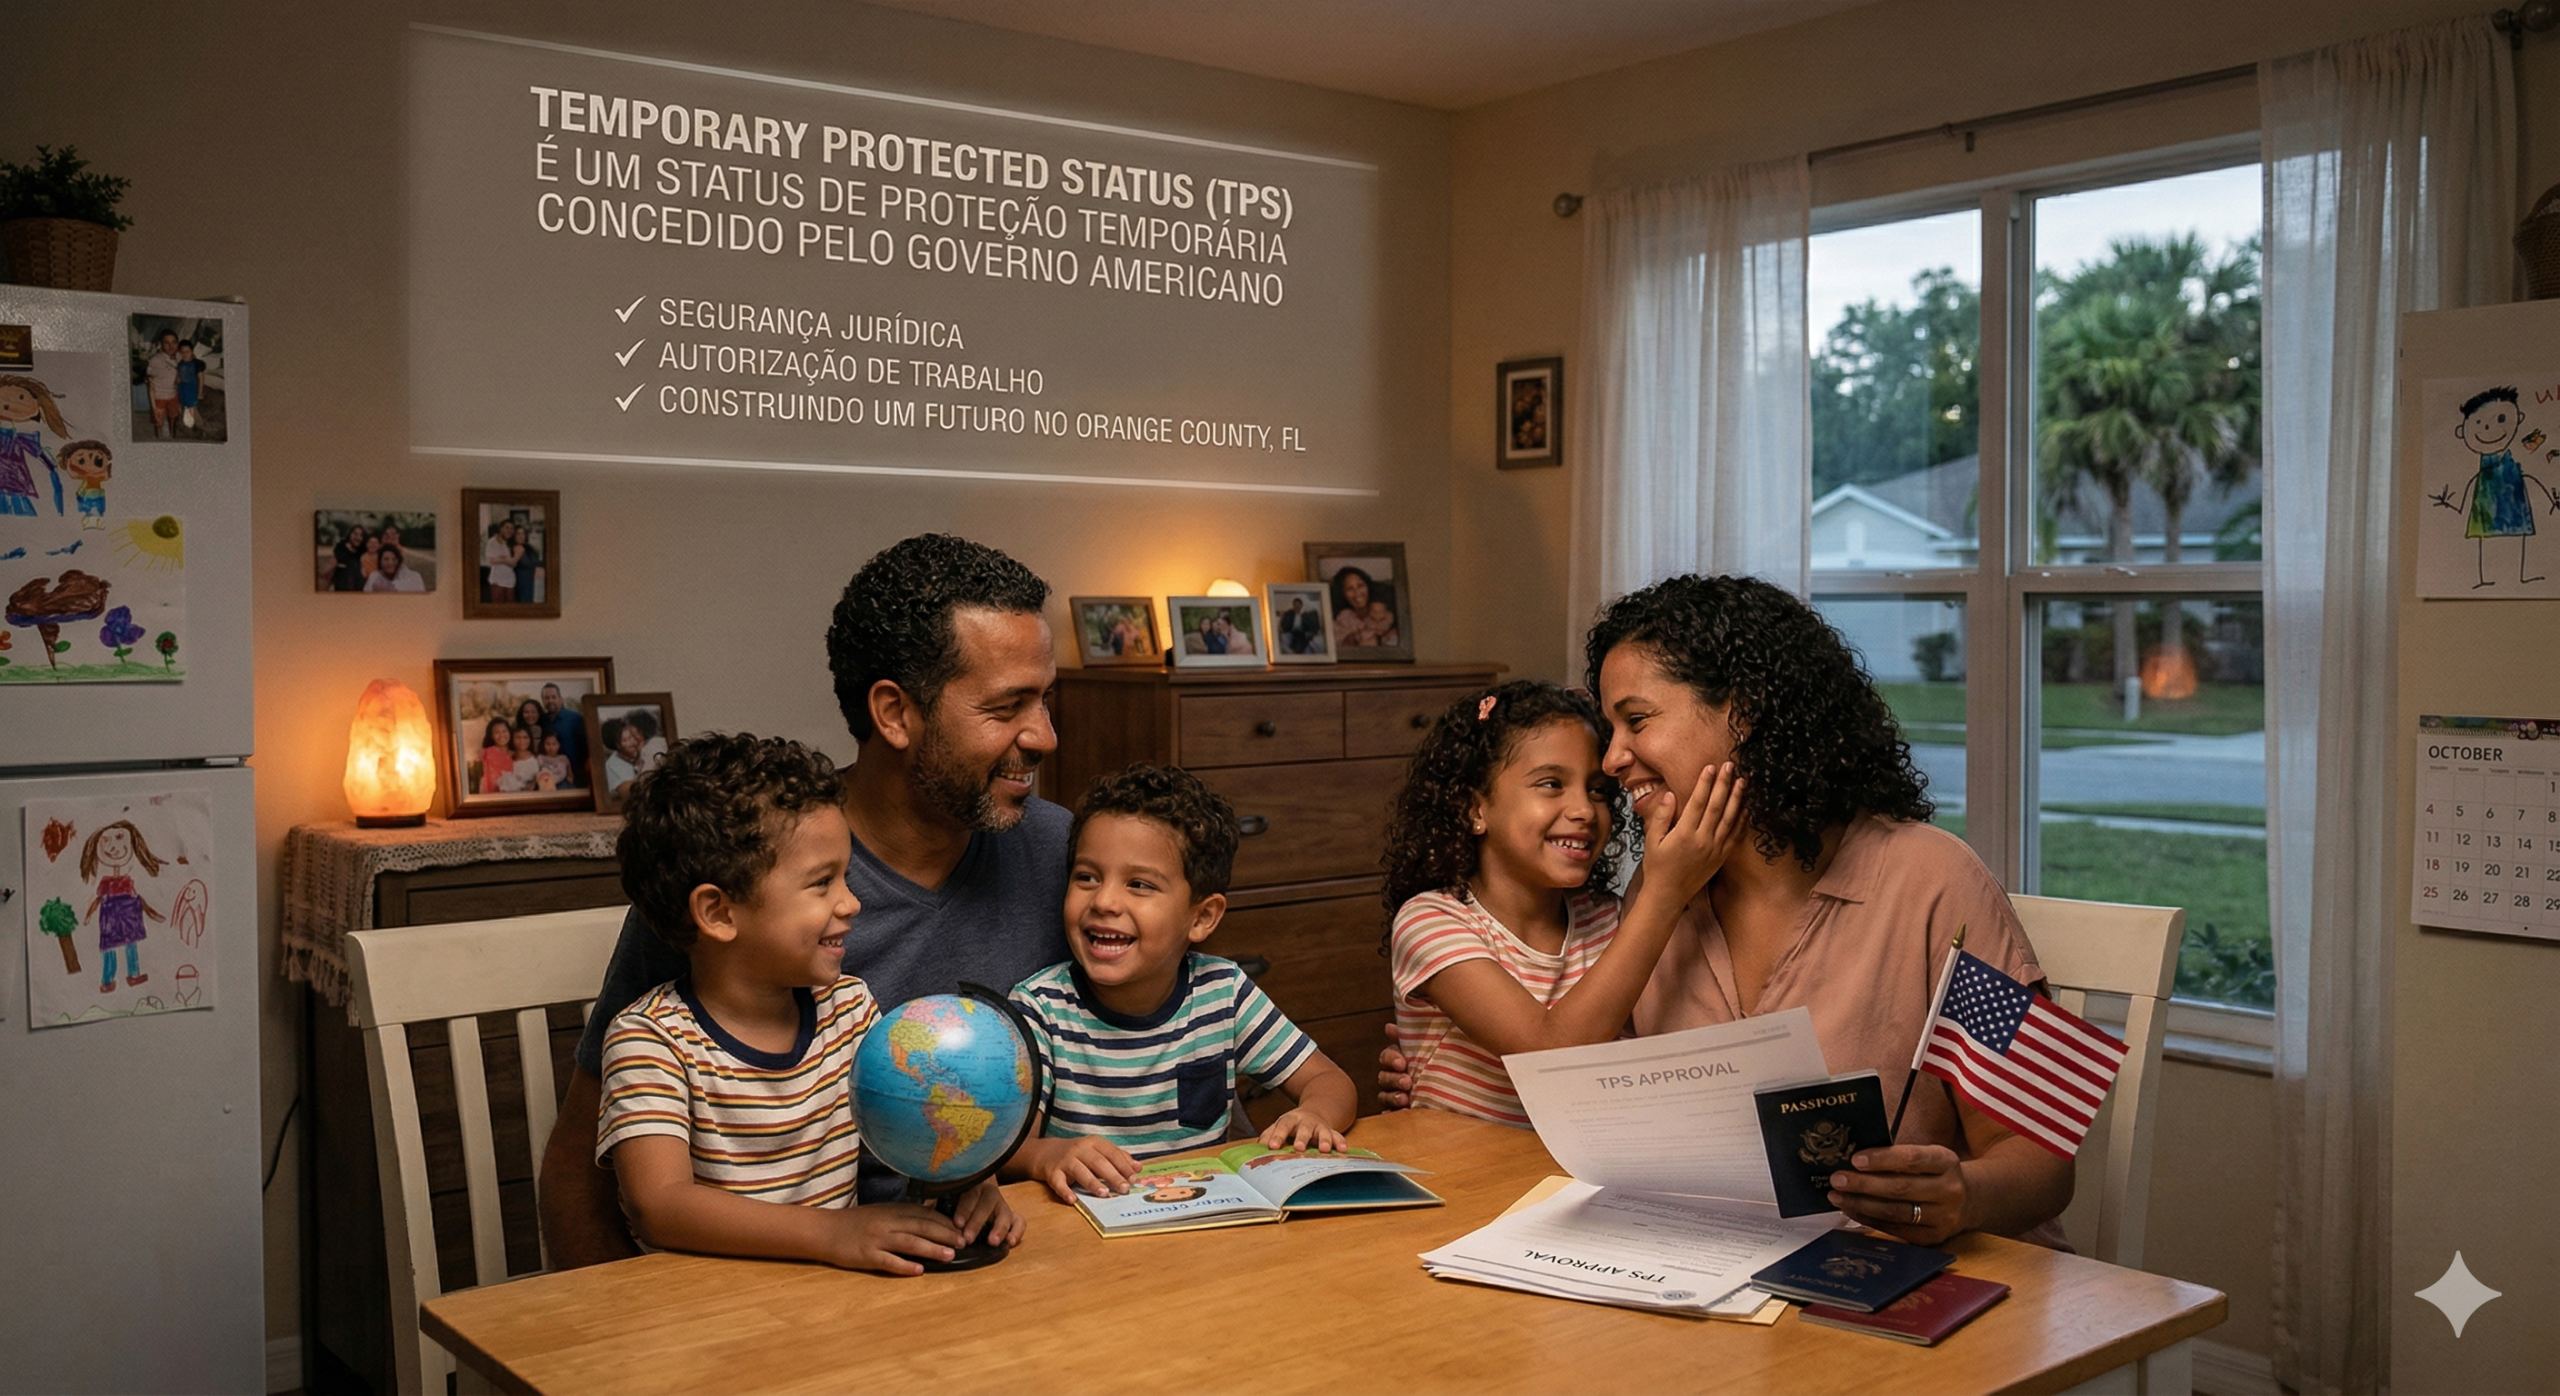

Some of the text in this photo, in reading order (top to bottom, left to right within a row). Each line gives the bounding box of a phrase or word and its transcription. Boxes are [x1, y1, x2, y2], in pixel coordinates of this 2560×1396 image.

[530, 86, 1293, 228] TEMPORARY PROTECTED STATUS (TPS)
[537, 134, 1288, 265] É UM STATUS DE PROTEÇÃO TEMPORÁRIA
[537, 192, 1284, 306] CONCEDIDO PELO GOVERNO AMERICANO
[660, 298, 964, 349] SEGURANÇA JURÍDICA
[659, 342, 1044, 395] AUTORIZAÇÃO DE TRABALHO
[660, 386, 1306, 453] CONSTRUINDO UM FUTURO NO ORANGE COUNTY, FL
[2428, 745, 2503, 761] OCTOBER
[2551, 781, 2556, 793] 1
[2426, 804, 2556, 823] 4 5 6 7 8
[2426, 831, 2439, 843] 11
[2456, 833, 2471, 845] 12
[2486, 836, 2501, 848] 13
[2517, 838, 2532, 850] 14
[2426, 858, 2440, 870] 18
[2455, 861, 2470, 872] 19
[2484, 864, 2501, 876] 20
[2515, 866, 2529, 878] 21
[2423, 886, 2438, 898] 25
[2453, 889, 2469, 901] 26
[2483, 892, 2499, 904] 27
[2514, 895, 2530, 907] 28
[1596, 1061, 1740, 1090] TPS APPROVAL
[1780, 1092, 1858, 1114] PASSPORT
[1524, 1249, 1628, 1276] APPROVAL
[1628, 1269, 1668, 1284] TPS
